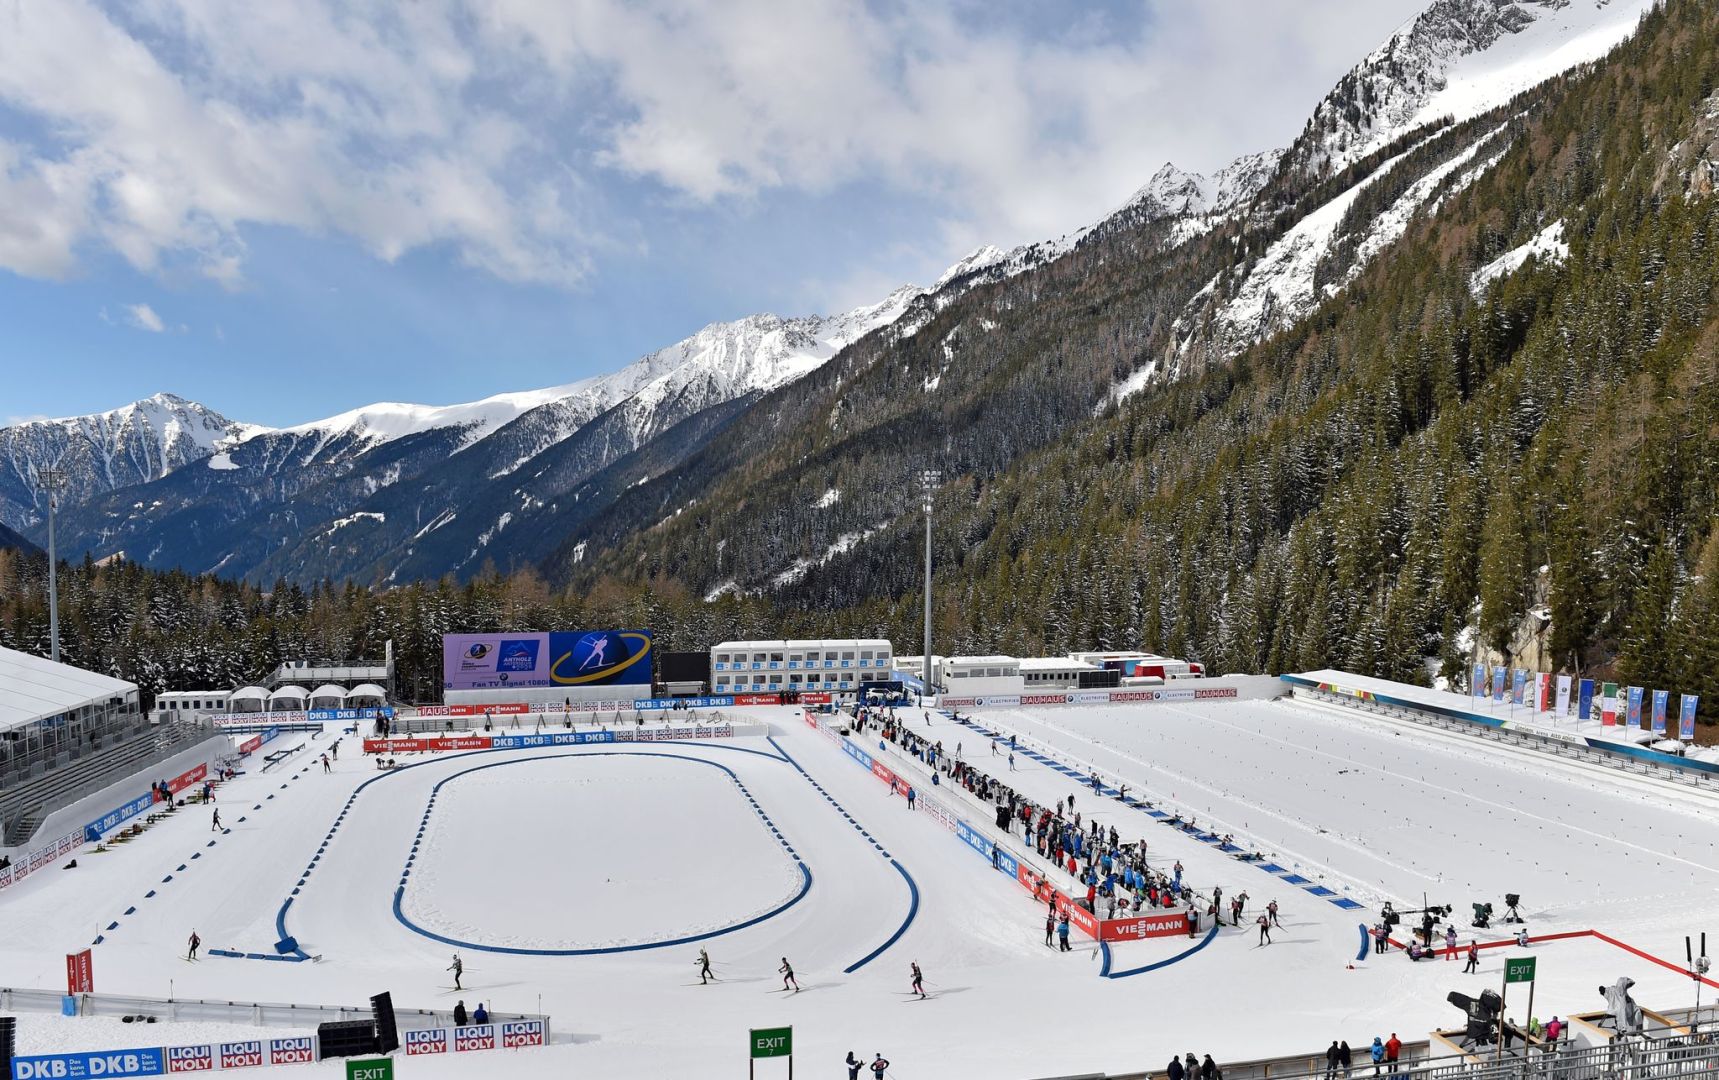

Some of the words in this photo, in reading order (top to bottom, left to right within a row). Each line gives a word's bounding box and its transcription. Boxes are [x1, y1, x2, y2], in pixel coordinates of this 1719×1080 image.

[502, 680, 526, 688] Signal
[1022, 696, 1066, 704] BAUHAUS
[1110, 692, 1152, 701] BAUHAUS
[1196, 690, 1236, 698] BAUHAUS
[438, 739, 481, 749] VIESSMANN
[493, 738, 514, 747] DKB
[524, 736, 544, 745] DKB
[555, 735, 575, 743] DKB
[373, 740, 417, 751] VIESSMANN
[138, 798, 148, 810] DKB
[122, 805, 134, 819] DKB
[104, 814, 116, 829] DKB
[971, 832, 980, 848] DKB
[1001, 855, 1012, 872] DKB
[1116, 920, 1182, 938] VIESSMANN
[1510, 966, 1531, 975] EXIT
[456, 1026, 493, 1039] LIQUI
[504, 1022, 540, 1035] LIQUI
[407, 1030, 445, 1043] LIQUI
[504, 1034, 541, 1047] MOLY
[222, 1043, 259, 1055] LIQUI
[272, 1038, 310, 1051] LIQUI
[408, 1042, 446, 1054] MOLY
[456, 1038, 494, 1050] MOLY
[757, 1037, 785, 1049] EXIT
[170, 1047, 210, 1059] LIQUI
[273, 1050, 311, 1063] MOLY
[89, 1055, 139, 1075] DKB
[172, 1059, 211, 1071] MOLY
[224, 1054, 261, 1067] MOLY
[16, 1060, 67, 1080] DKB
[354, 1068, 385, 1080] EXIT
